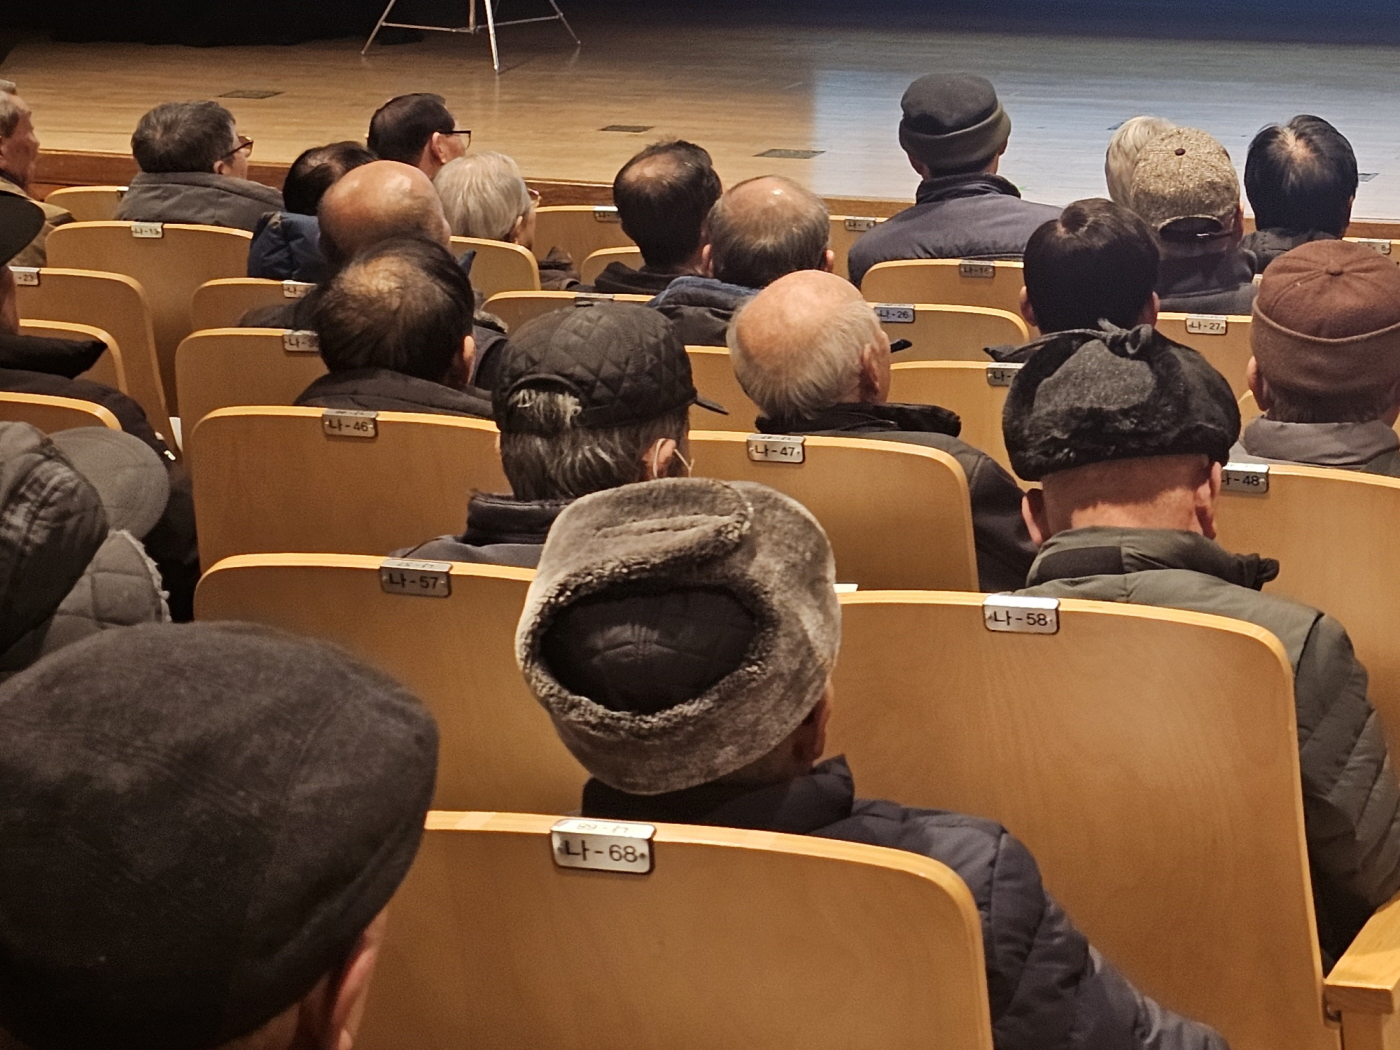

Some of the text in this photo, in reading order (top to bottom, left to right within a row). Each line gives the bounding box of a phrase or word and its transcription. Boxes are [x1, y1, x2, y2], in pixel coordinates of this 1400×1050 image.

[328, 418, 369, 432] 나-46
[755, 444, 796, 457] 나-47
[389, 572, 439, 590] 나-57
[993, 610, 1048, 627] 나-58
[564, 839, 638, 863] 나-68
